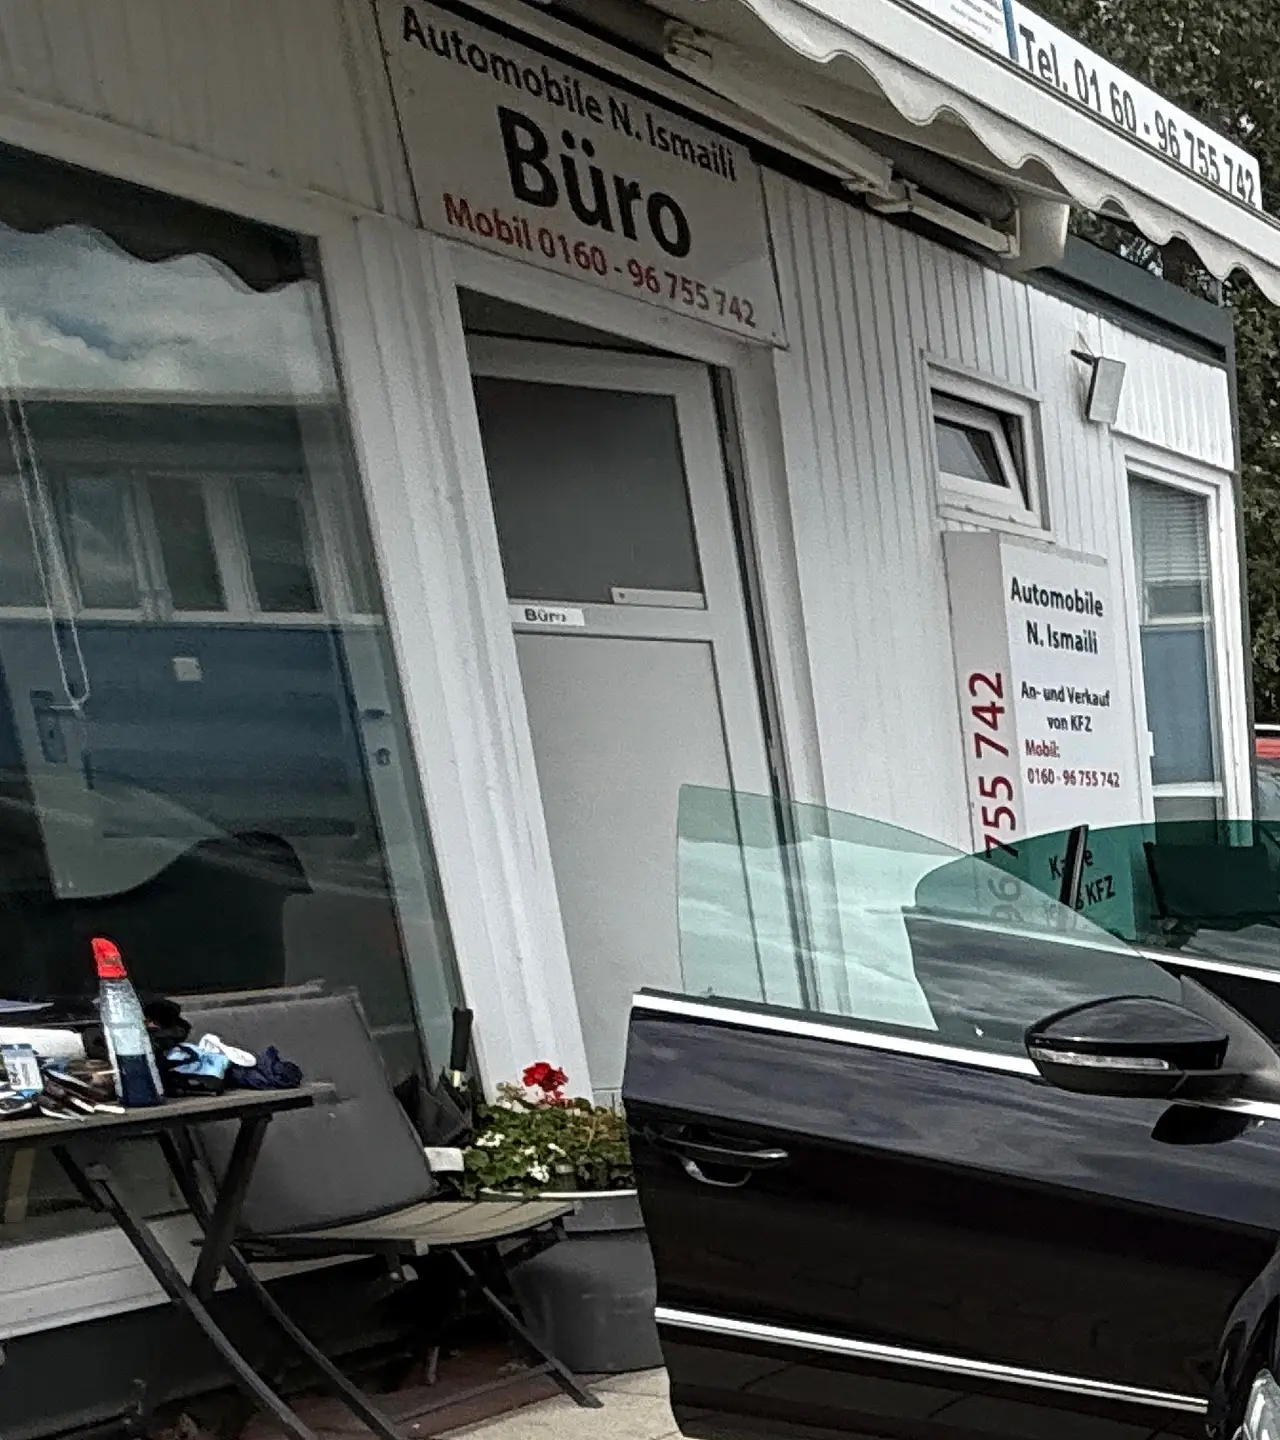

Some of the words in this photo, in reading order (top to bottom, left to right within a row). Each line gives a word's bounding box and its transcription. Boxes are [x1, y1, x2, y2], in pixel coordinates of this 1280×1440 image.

[402, 5, 604, 125] Automobile
[609, 97, 642, 141] N.
[648, 113, 738, 182] Ismaili
[1019, 23, 1068, 92] Tel.
[1074, 58, 1102, 113] 01
[1109, 81, 1137, 136] 60
[1155, 110, 1181, 161] 96
[1184, 128, 1220, 185] 755
[1224, 154, 1256, 206] 742
[498, 105, 691, 258] Büro
[443, 192, 532, 252] Mobil
[538, 229, 608, 276] 0160
[628, 258, 661, 294] 96
[664, 272, 711, 311] 755
[714, 290, 756, 327] 742
[1010, 576, 1104, 617] Automobile
[1026, 620, 1044, 647] N.
[1047, 624, 1098, 654] Ismaili
[1021, 680, 1041, 700] An-
[1042, 686, 1065, 702] und
[1066, 686, 1110, 707] Verkauf
[968, 672, 1011, 758] 742
[1047, 716, 1068, 730] von
[1070, 714, 1093, 732] KFZ
[1027, 767, 1055, 784] 0160
[1063, 769, 1077, 786] 96
[1078, 770, 1098, 787] 755
[1100, 771, 1120, 788] 742
[1085, 875, 1116, 906] KFZ
